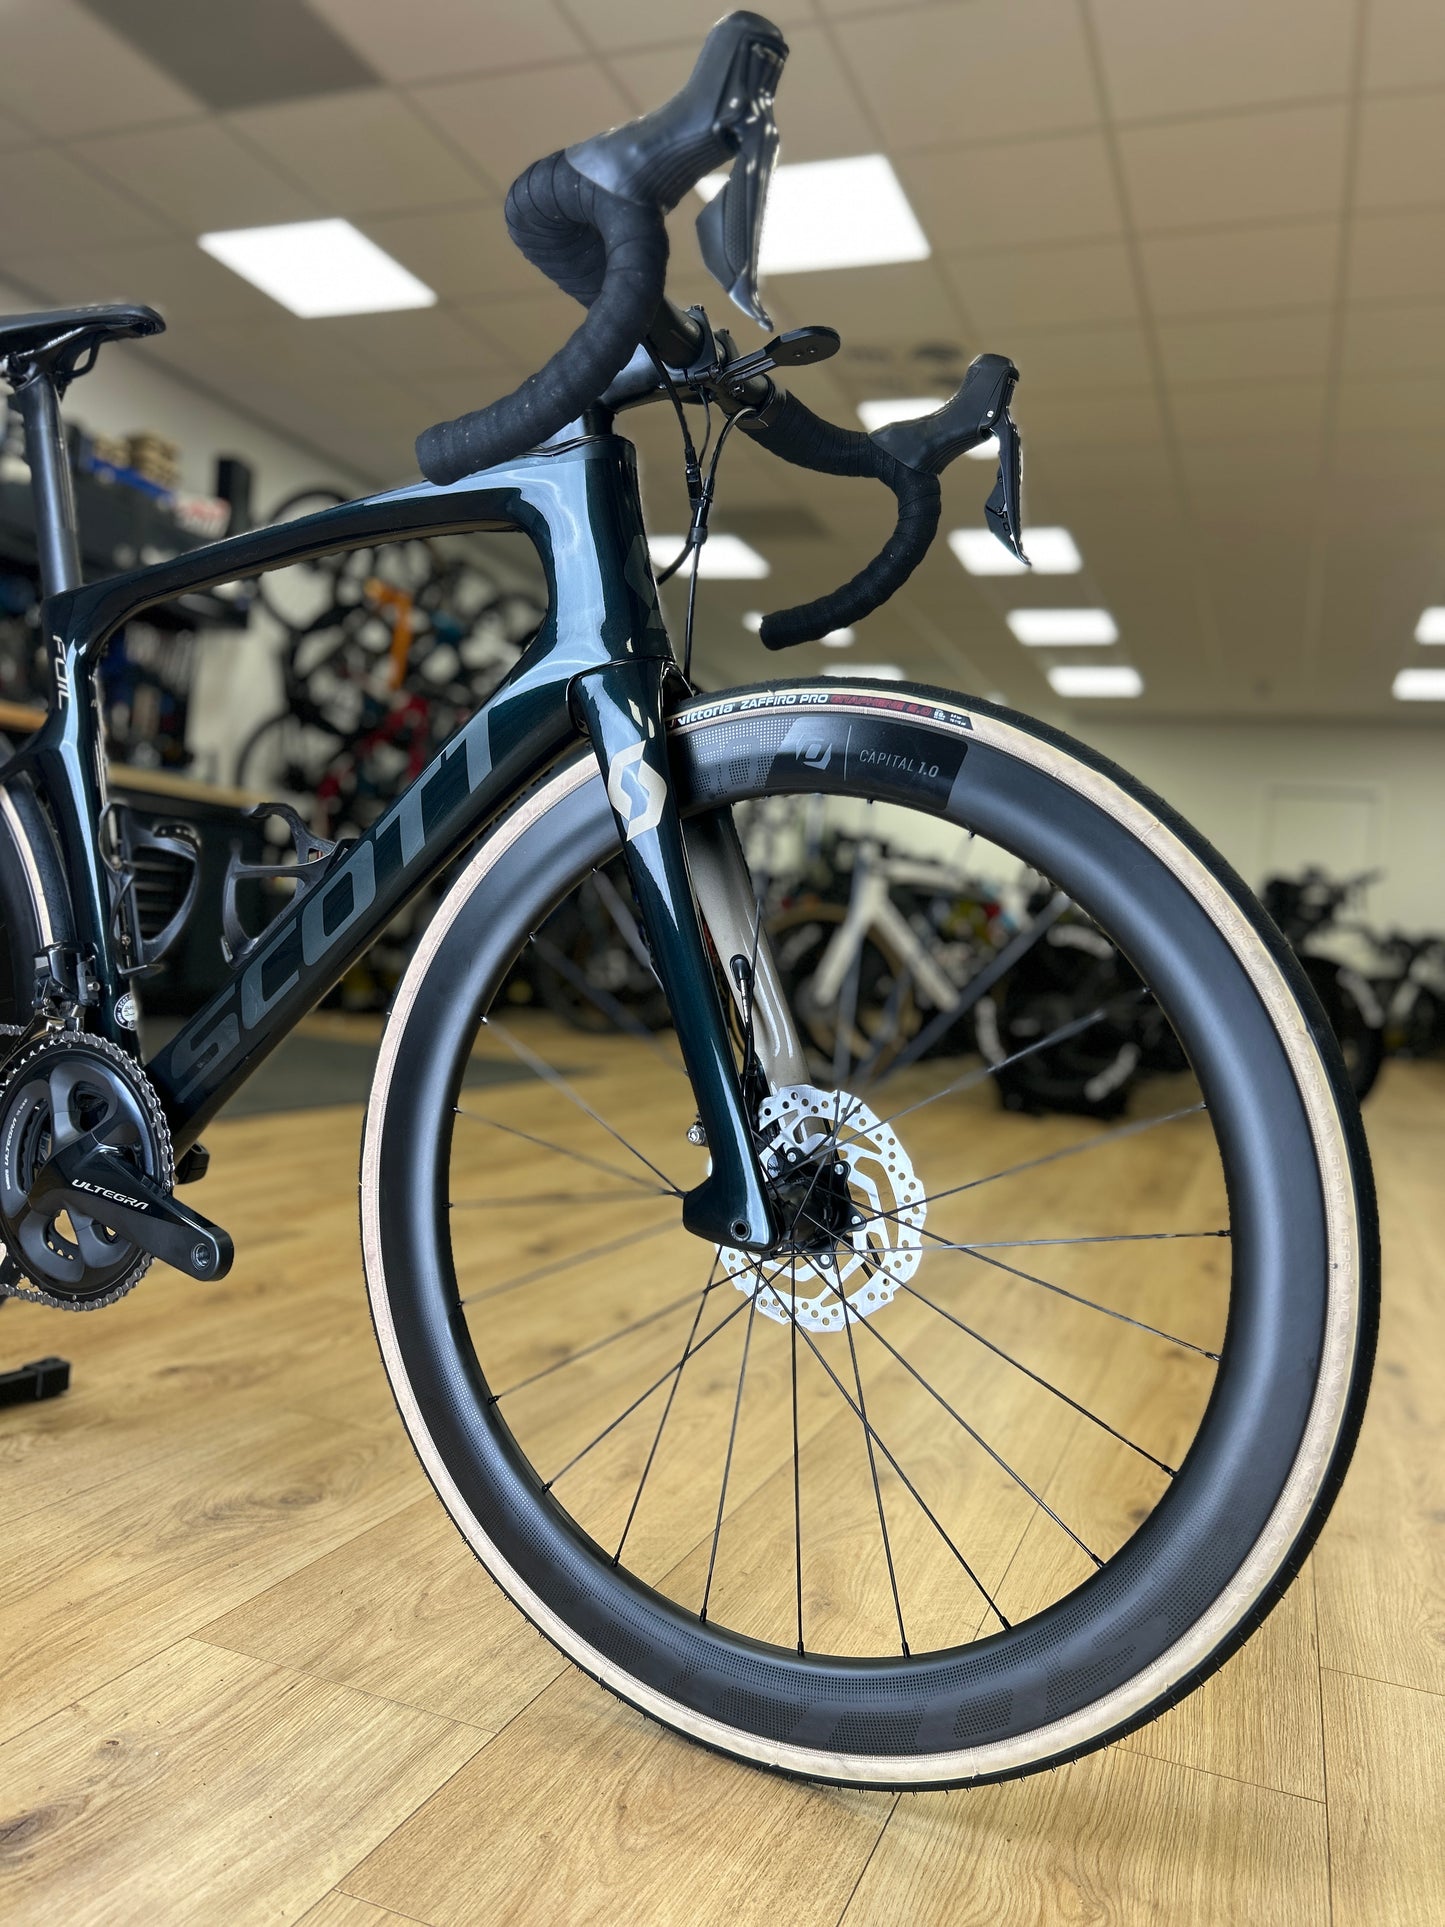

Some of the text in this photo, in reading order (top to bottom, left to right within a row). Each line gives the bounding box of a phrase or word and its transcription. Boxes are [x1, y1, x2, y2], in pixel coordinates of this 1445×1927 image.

[52, 634, 70, 710] FOIL
[677, 703, 734, 726] vittoria
[740, 695, 797, 711] ZAFFIRO
[799, 694, 829, 704] PRO
[859, 749, 939, 778] CAPITAL 1.0
[170, 682, 508, 1101] SCOTT
[71, 1178, 149, 1210] ULTEGRA
